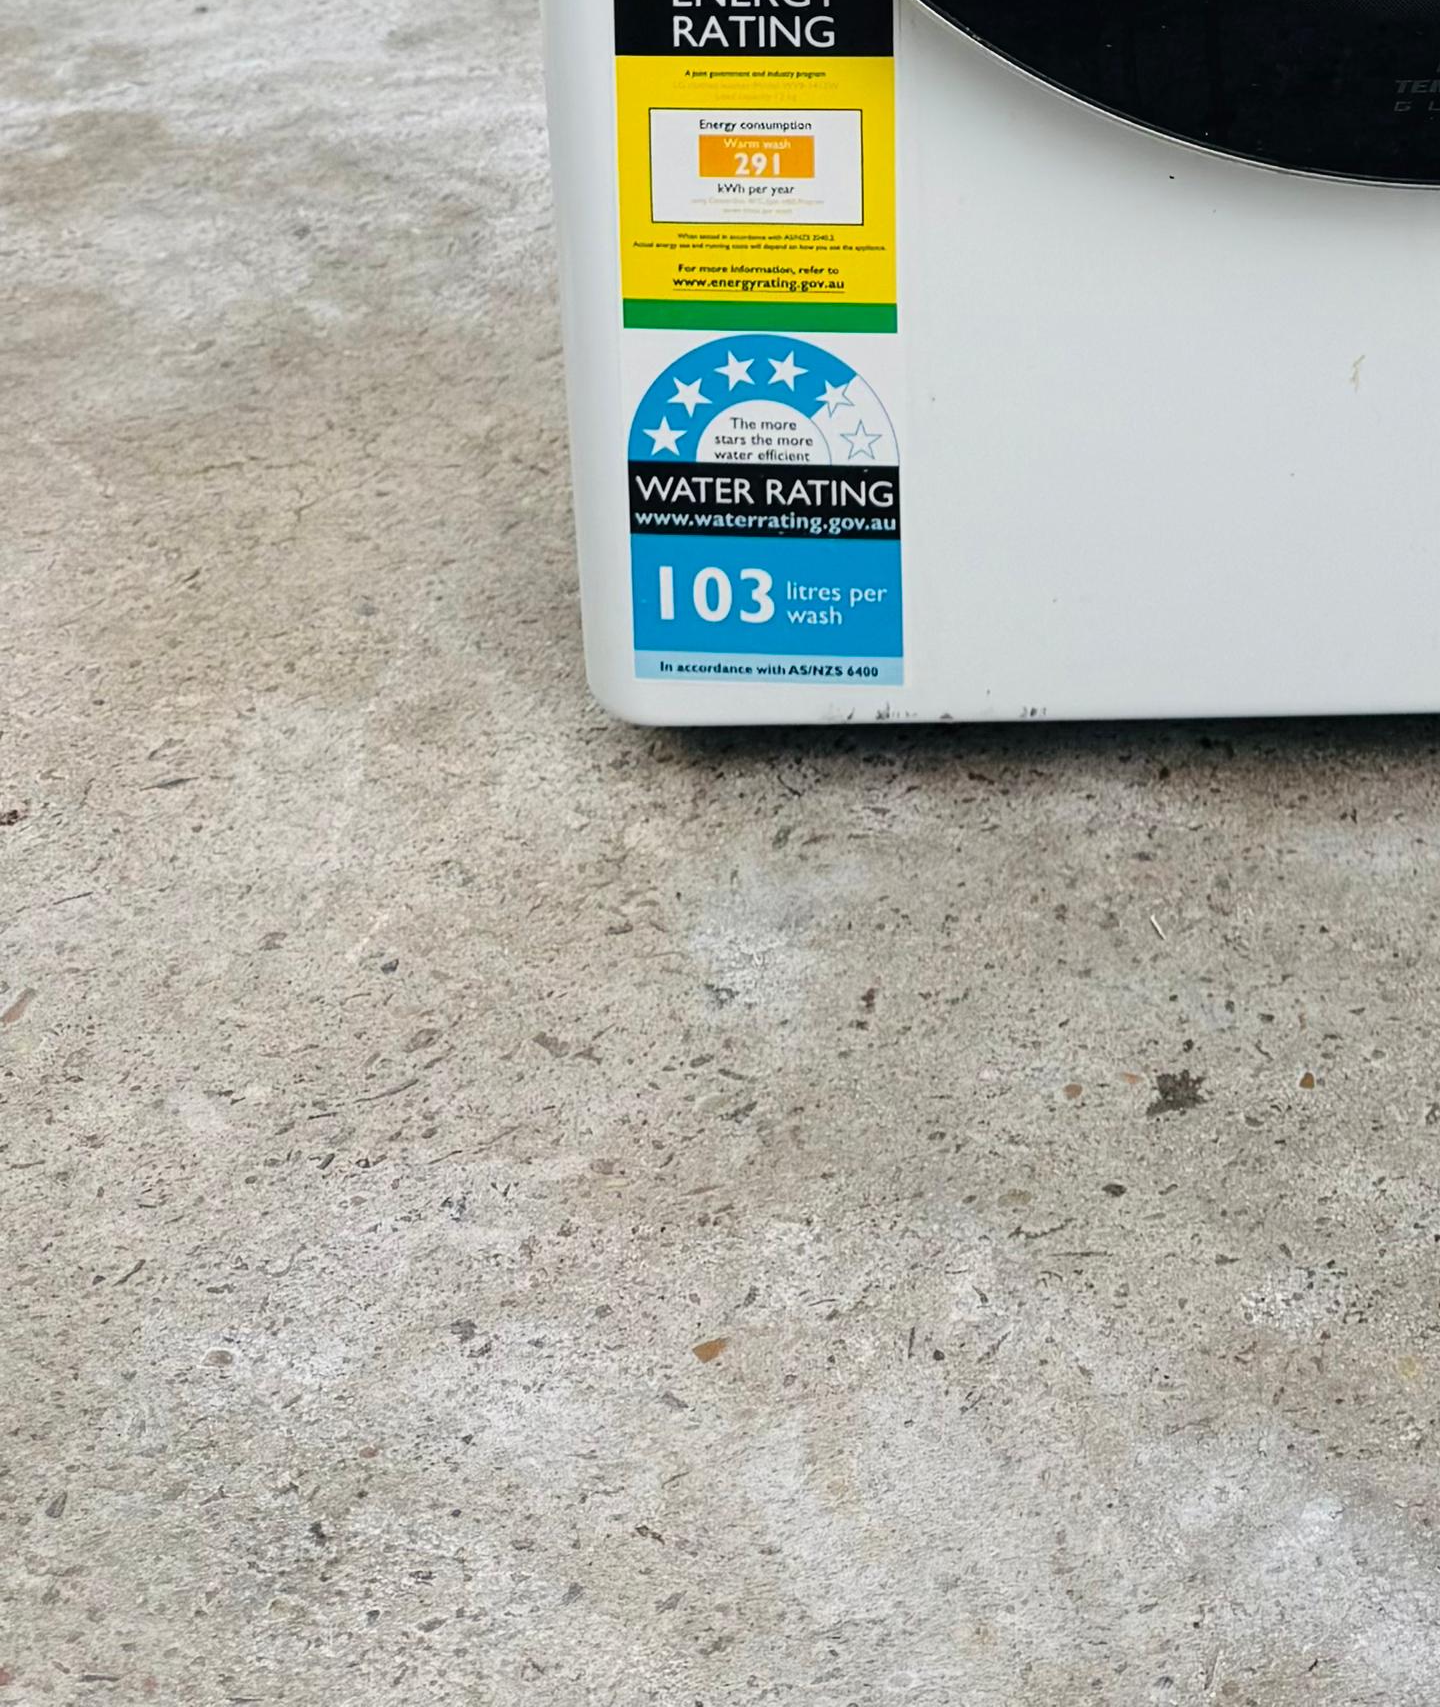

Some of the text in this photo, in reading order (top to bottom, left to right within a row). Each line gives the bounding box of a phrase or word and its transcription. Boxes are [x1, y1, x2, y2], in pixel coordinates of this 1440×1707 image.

[672, 15, 836, 48] RATING
[699, 119, 812, 132] Energy consumption
[723, 138, 792, 150] Warm wash
[734, 152, 781, 176] 291
[717, 183, 795, 197] kWh per year
[678, 263, 839, 277] For more information, refer to
[673, 277, 845, 292] www.energyrating.gov.au
[730, 417, 797, 432] The more
[714, 434, 813, 447] stars the more
[714, 449, 810, 463] water efficient
[635, 476, 894, 507] WATER RATING
[635, 510, 897, 535] www.waterrating.gov.au
[659, 565, 888, 624] 103 litres per
[786, 607, 843, 625] wash
[660, 661, 879, 678] In accordance with AS/NZS 6400
